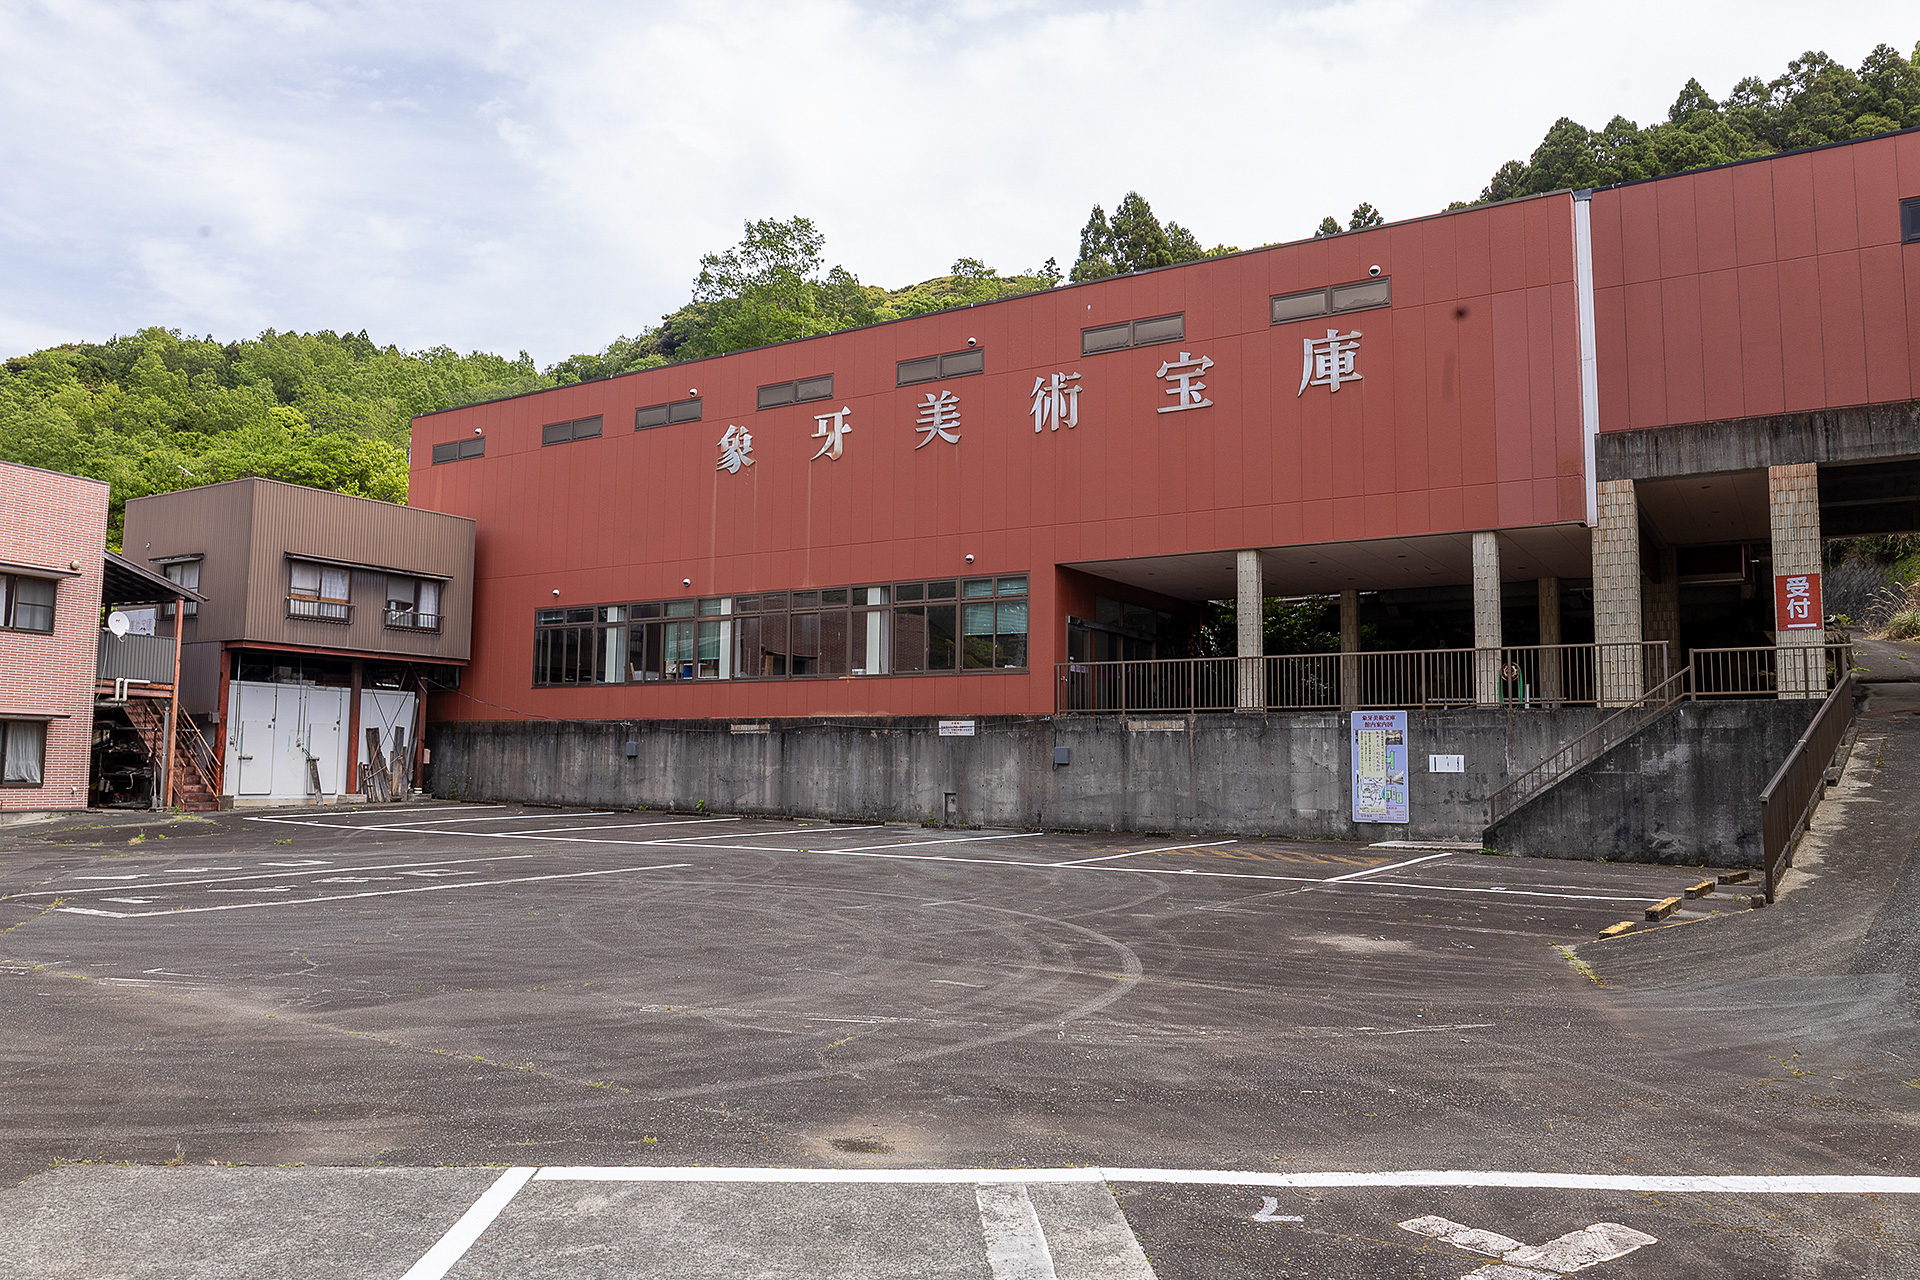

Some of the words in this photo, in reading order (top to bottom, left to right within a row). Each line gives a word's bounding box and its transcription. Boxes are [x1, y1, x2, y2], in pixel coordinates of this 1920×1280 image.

[716, 328, 1364, 475] 象牙美術宝庫
[1786, 576, 1811, 619] 受付
